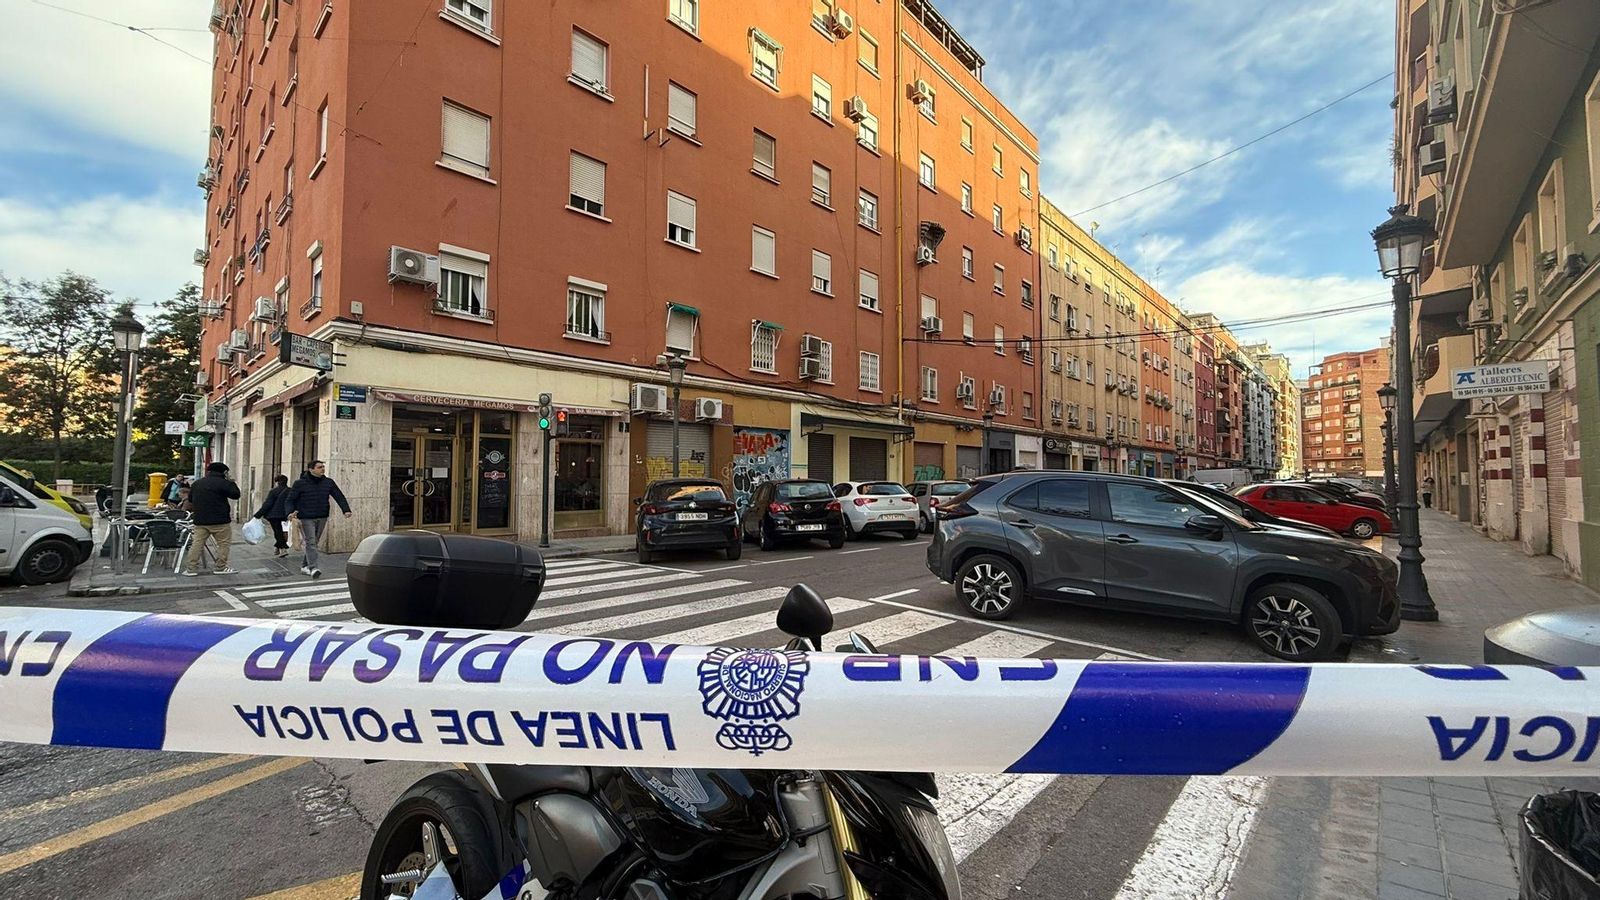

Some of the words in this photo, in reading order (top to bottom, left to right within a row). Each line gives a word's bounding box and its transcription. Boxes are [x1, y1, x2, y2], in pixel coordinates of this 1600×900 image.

[1479, 366, 1522, 377] Talleres
[1480, 373, 1544, 385] ALBEROTECNIC
[413, 394, 469, 407] CERVECERIA
[473, 399, 514, 411] MEGAMOS
[244, 624, 534, 683] PASAR
[542, 638, 681, 685] NO
[723, 676, 763, 701] NACIONAL
[763, 663, 787, 697] CUERPO
[233, 704, 423, 744] POLICIA
[430, 709, 505, 746] DE
[510, 711, 677, 750] LINEA
[647, 776, 698, 818] HONDA
